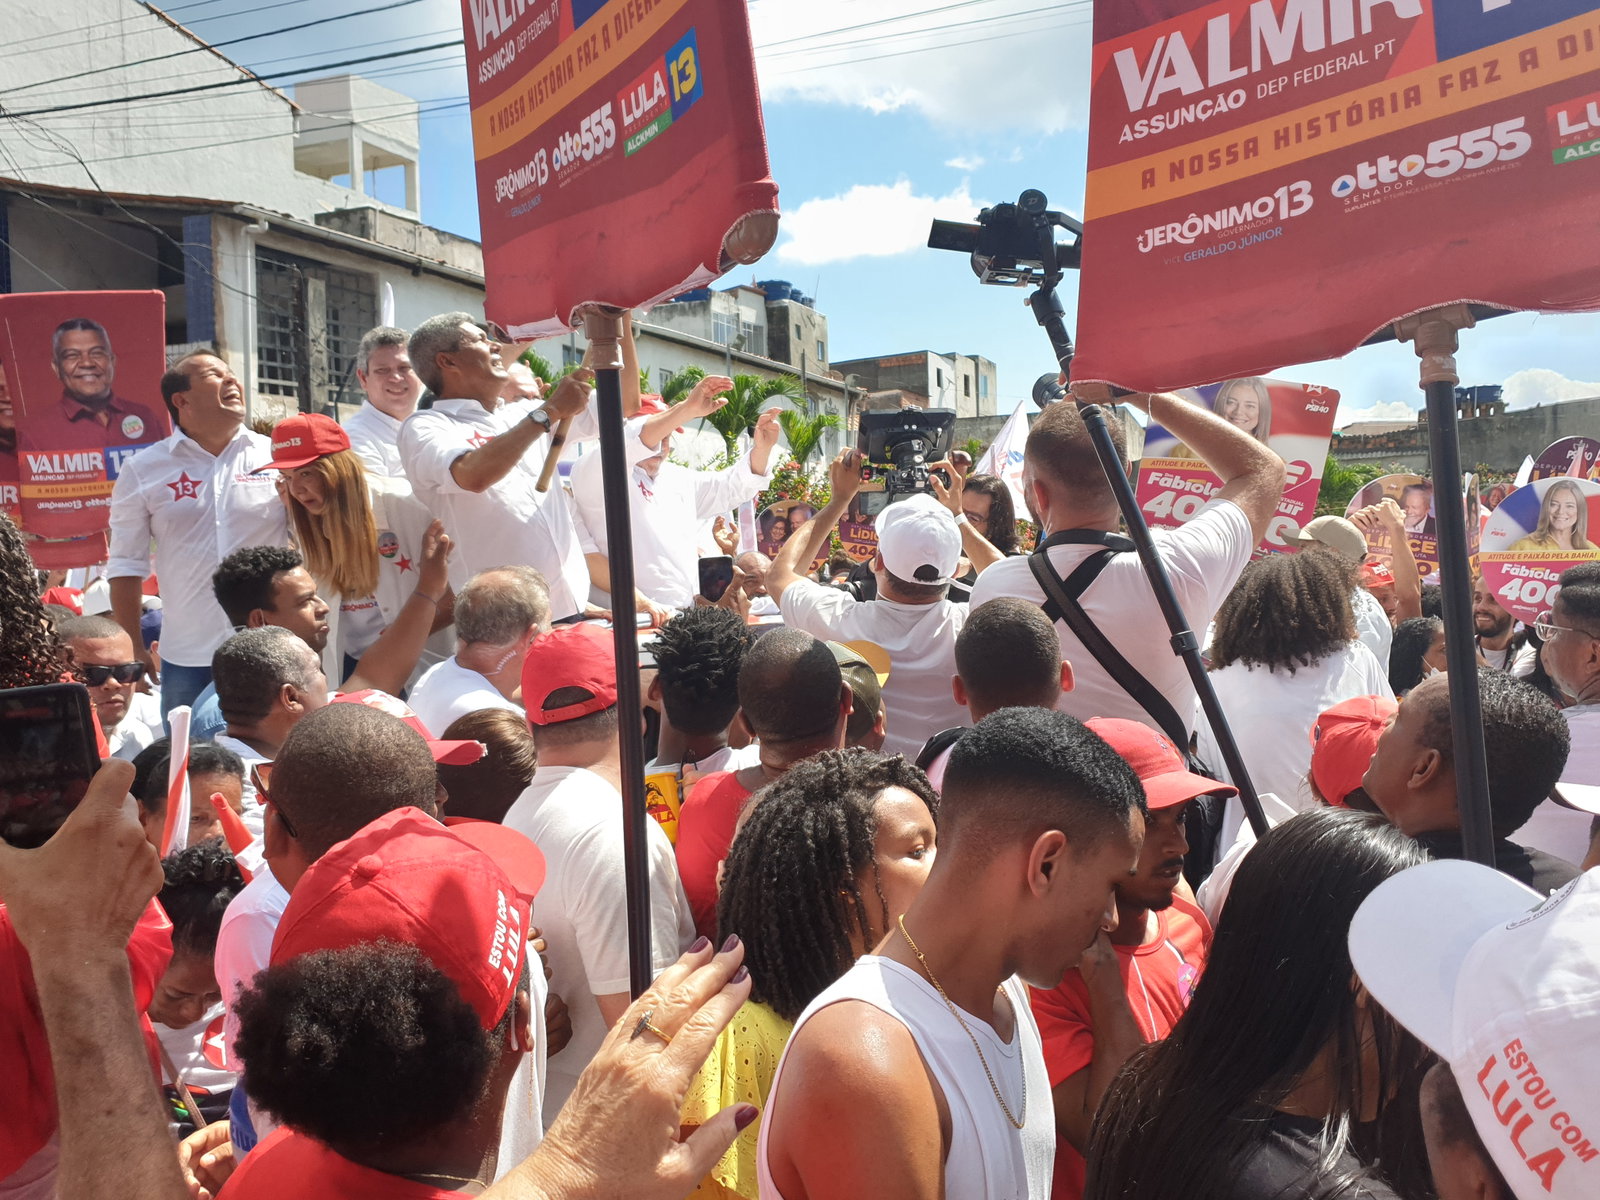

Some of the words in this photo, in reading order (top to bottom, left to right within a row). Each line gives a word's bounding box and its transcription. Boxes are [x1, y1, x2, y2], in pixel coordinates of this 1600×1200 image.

[489, 114, 496, 136] A
[498, 95, 526, 133] NOSSA
[527, 54, 574, 113] HISTÓRIA
[577, 33, 599, 73] FAZ
[602, 22, 611, 52] A
[621, 70, 667, 127] LULA
[670, 46, 697, 102] 13
[1119, 88, 1247, 145] ASSUNÇÃO
[1257, 76, 1288, 99] DEP
[1294, 50, 1369, 87] FEDERAL
[1374, 39, 1396, 60] PT
[627, 122, 659, 152] ALCKMIN
[1141, 167, 1156, 190] A
[1169, 136, 1259, 183] NOSSA
[1274, 84, 1422, 150] HISTÓRIA
[1438, 59, 1502, 98] FAZ
[1518, 46, 1539, 73] A
[1344, 179, 1414, 205] SENADOR
[1183, 240, 1237, 262] GERALDO
[1238, 225, 1283, 250] JÚNIOR
[1217, 216, 1274, 239] GOVERNADOR
[26, 451, 105, 473] VALMIR
[176, 481, 194, 496] 13
[1523, 551, 1550, 559] PAIXÃO
[1571, 551, 1597, 559] BAHIA!
[497, 888, 508, 921] COM
[488, 918, 507, 969] ESTOU
[503, 905, 521, 989] LULA
[1503, 1038, 1557, 1111] ESTOU
[1550, 1111, 1600, 1163] COM
[1477, 1053, 1566, 1193] LULA
